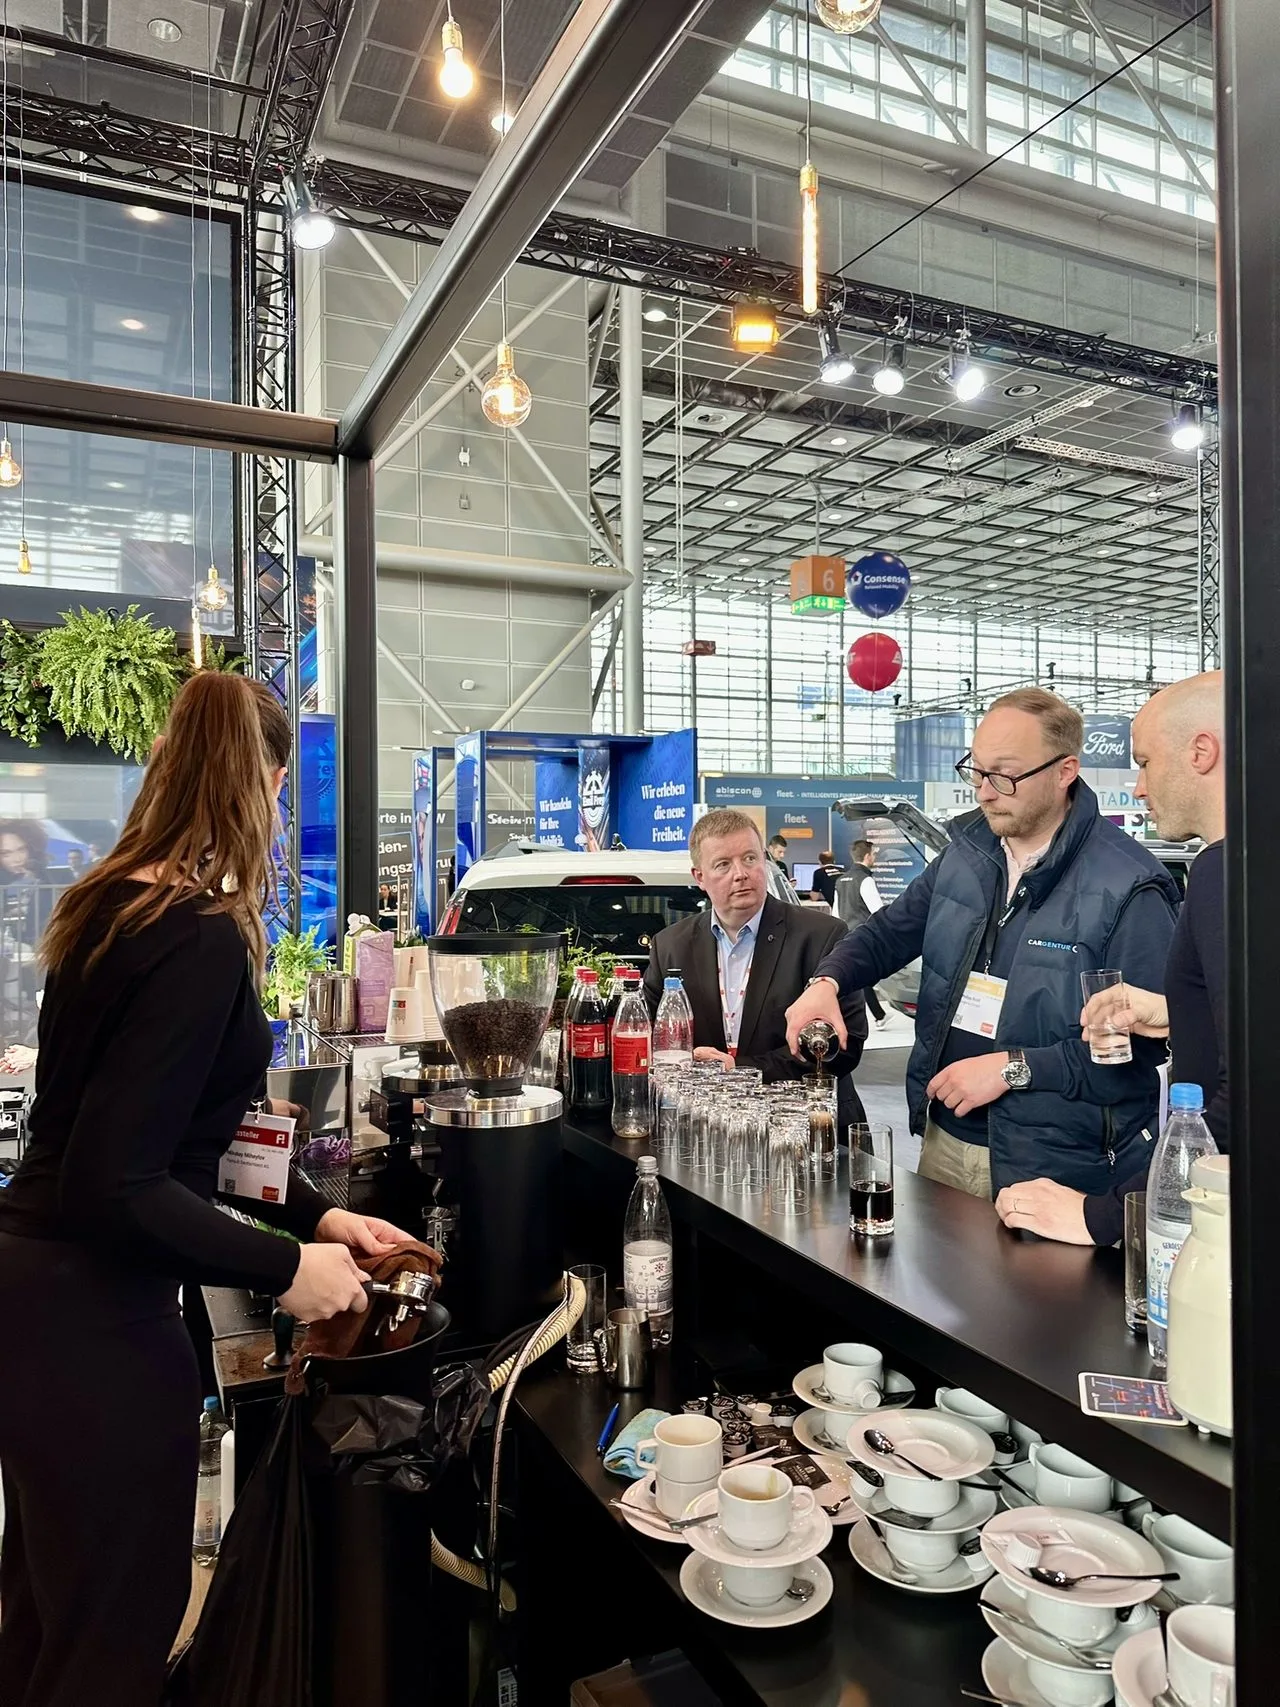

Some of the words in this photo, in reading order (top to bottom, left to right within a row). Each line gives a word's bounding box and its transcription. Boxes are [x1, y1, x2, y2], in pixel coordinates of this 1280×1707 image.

[823, 568, 835, 592] 6
[863, 575, 906, 584] Consense
[1082, 731, 1125, 756] Ford
[641, 784, 656, 800] Wir
[656, 781, 686, 798] erleben
[715, 786, 752, 794] abiscon
[953, 789, 979, 804] TH
[654, 804, 666, 820] die
[666, 806, 686, 819] neue
[784, 813, 808, 824] fleet.
[652, 826, 686, 842] Freiheit.
[1028, 939, 1072, 950] CARGENTUR
